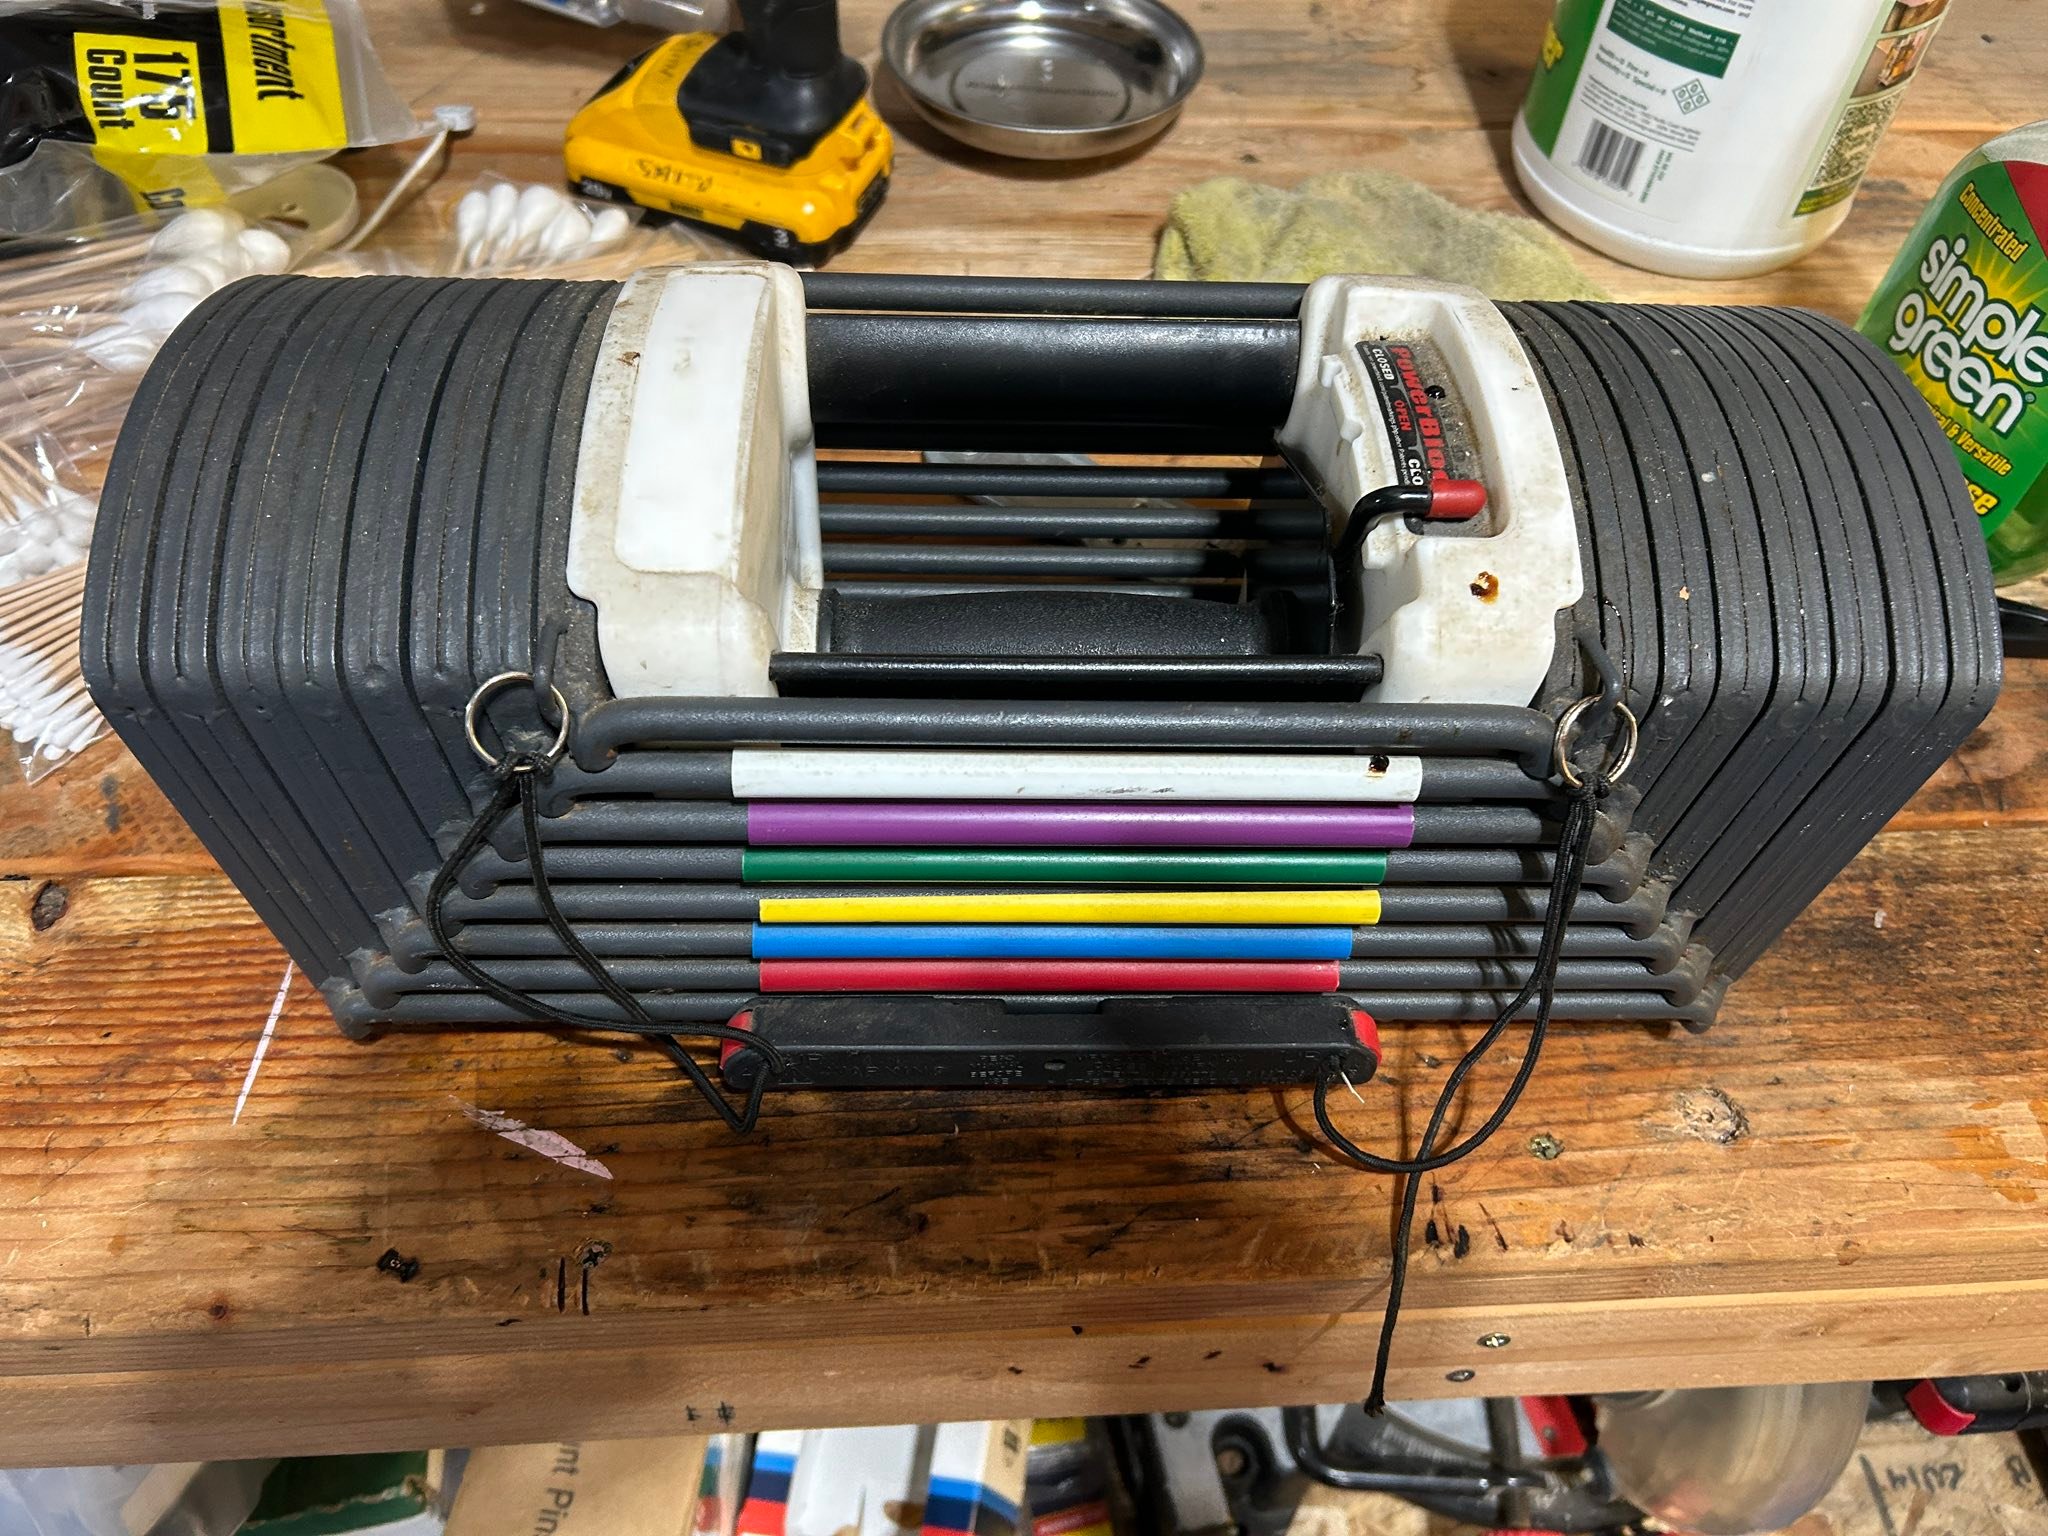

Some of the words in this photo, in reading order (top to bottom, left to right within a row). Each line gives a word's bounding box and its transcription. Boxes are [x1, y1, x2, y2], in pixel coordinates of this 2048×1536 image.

[86, 48, 134, 130] Count
[133, 50, 197, 121] 175
[1959, 182, 2028, 262] Concentrated
[1920, 236, 2048, 384] simple
[1372, 348, 1395, 380] CLOSED
[1889, 292, 2023, 434] green
[1394, 399, 1412, 431] OPEN
[1408, 458, 1424, 486] CLO
[1945, 423, 1961, 439] &
[1955, 429, 2013, 476] Versatile
[552, 1441, 580, 1476] nt
[533, 1487, 575, 1536] Pin
